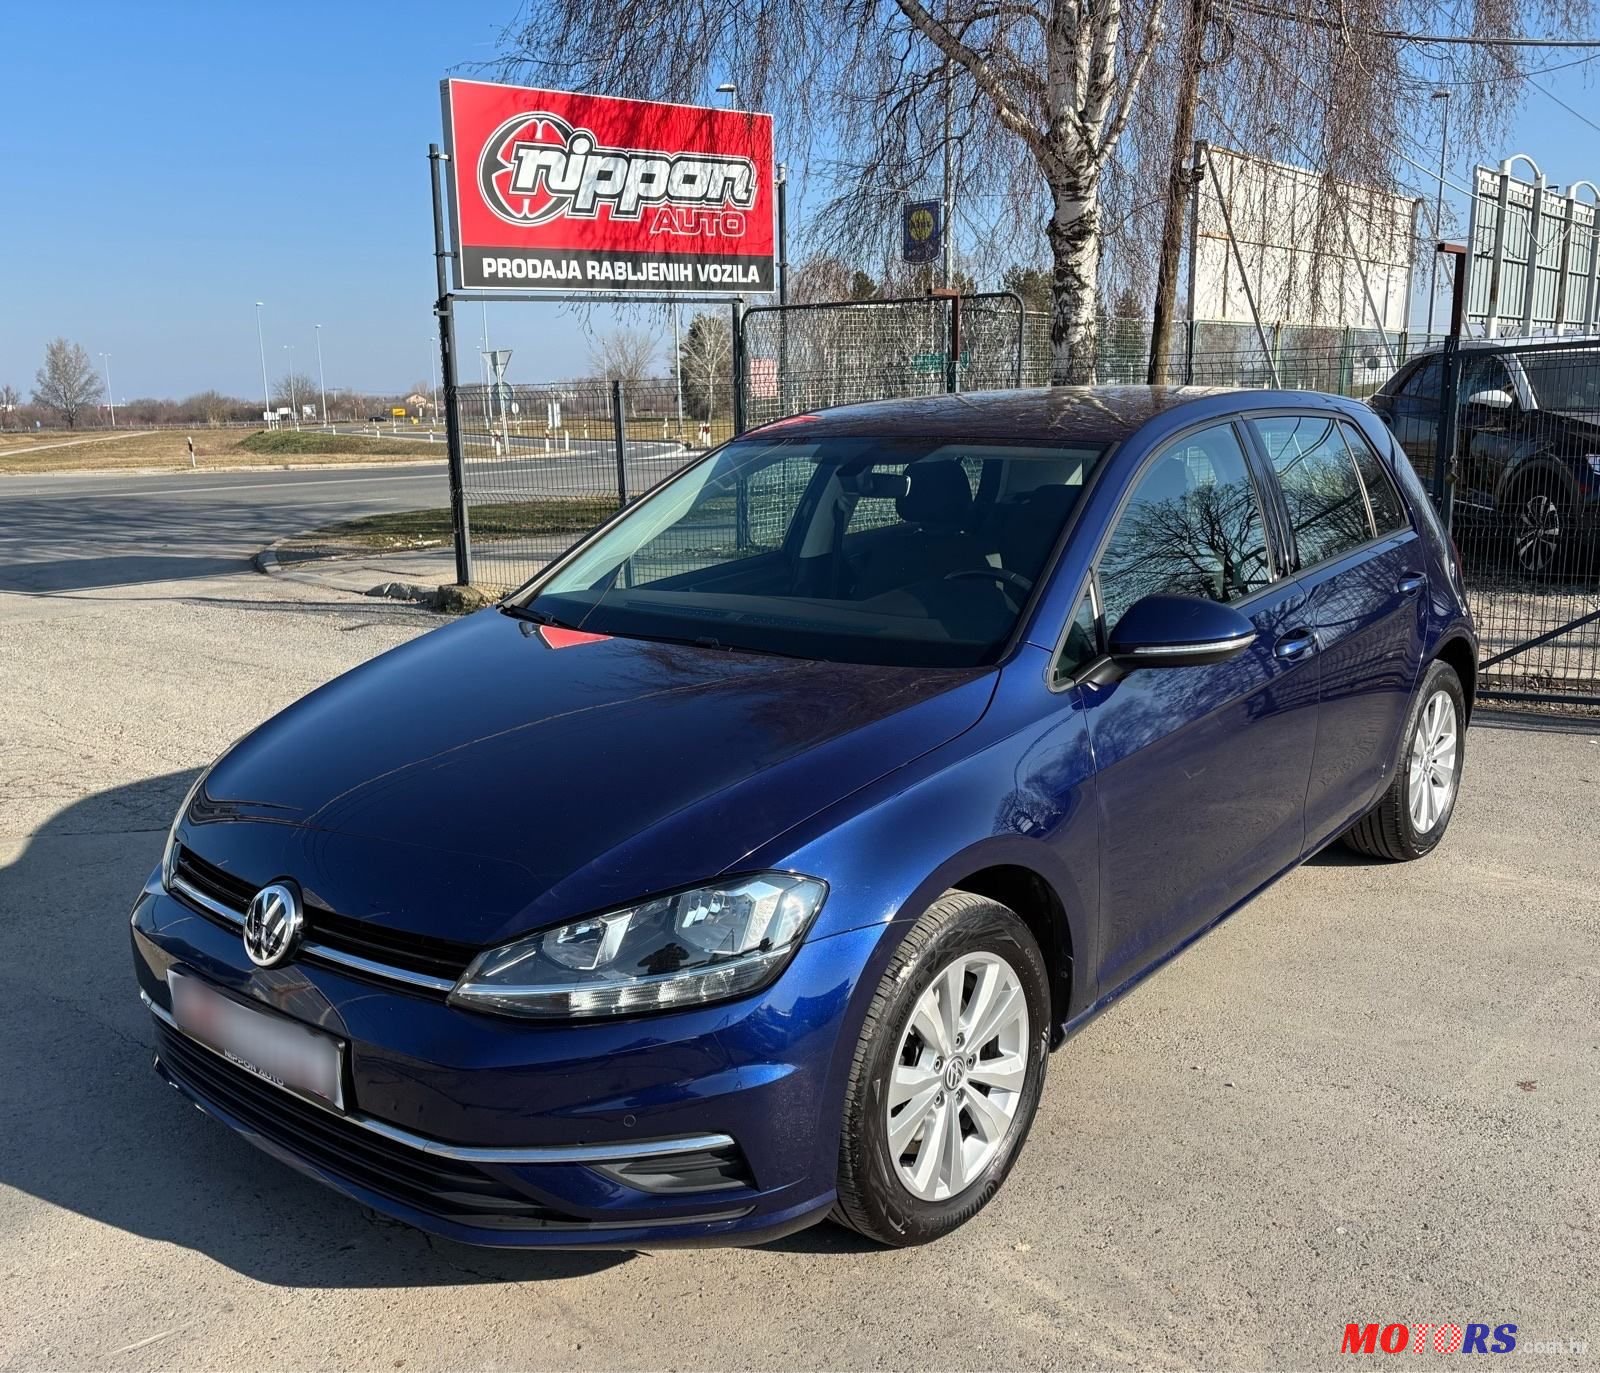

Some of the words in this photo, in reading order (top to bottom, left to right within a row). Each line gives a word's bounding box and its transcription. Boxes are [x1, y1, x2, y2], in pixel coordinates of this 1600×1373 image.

[512, 134, 757, 216] nippon
[650, 208, 745, 236] AUTO
[483, 257, 582, 280] PRODAJA
[587, 260, 693, 282] RABLJENIH
[696, 263, 760, 283] VOZILA
